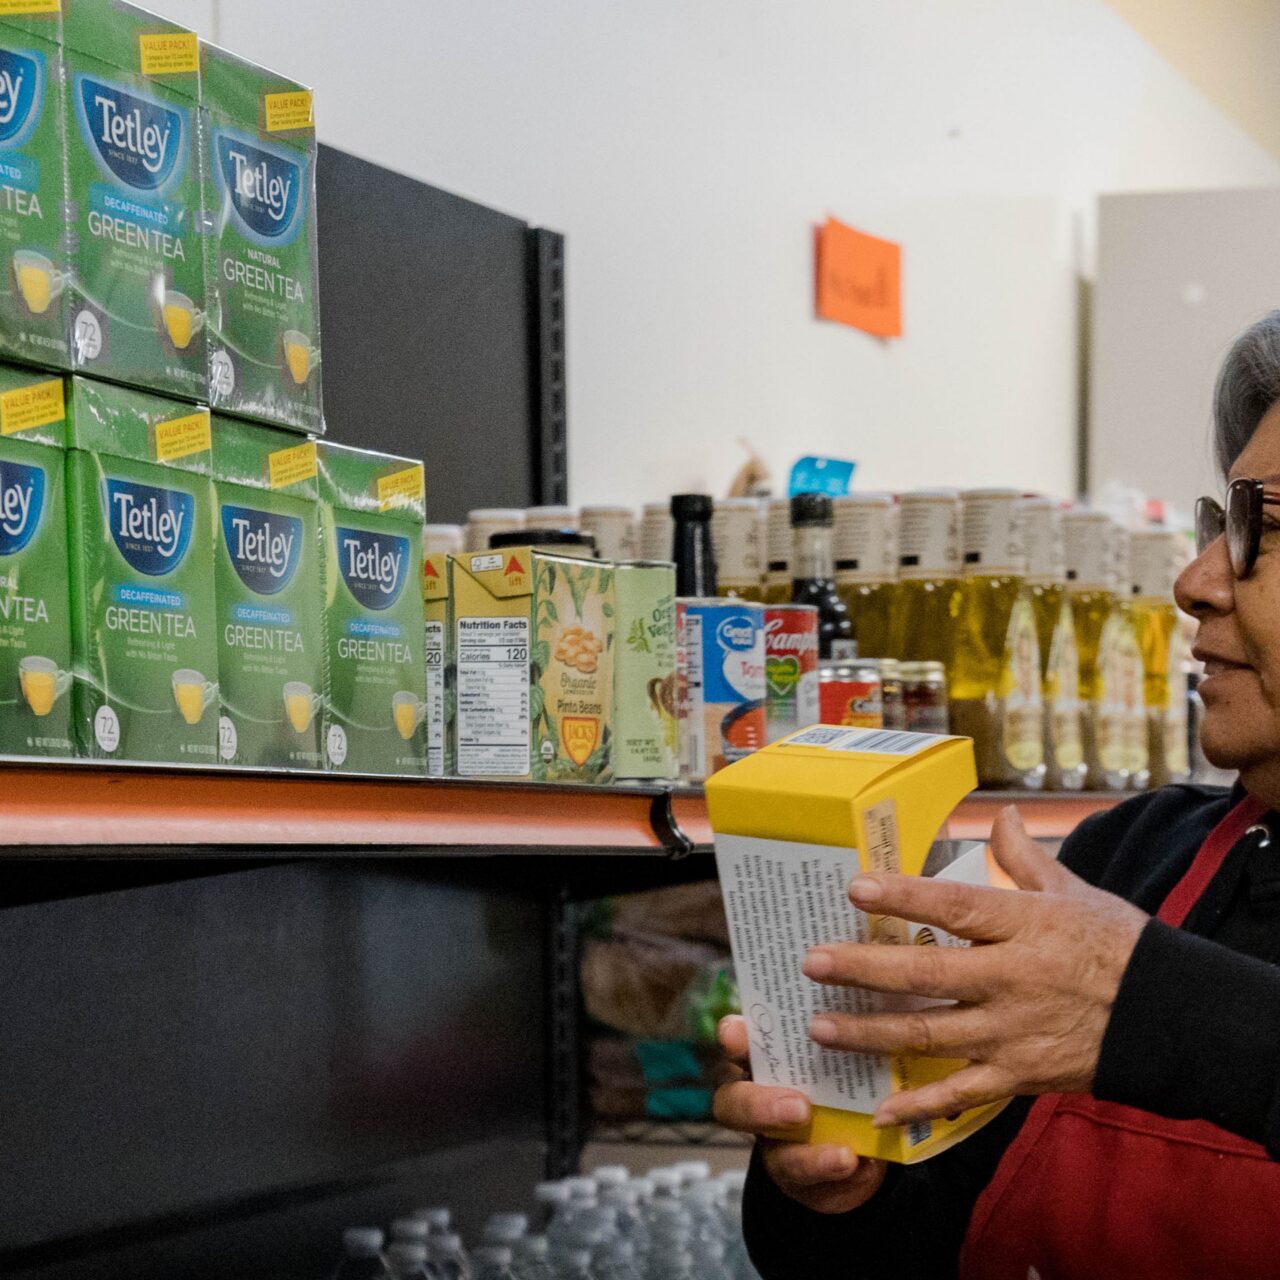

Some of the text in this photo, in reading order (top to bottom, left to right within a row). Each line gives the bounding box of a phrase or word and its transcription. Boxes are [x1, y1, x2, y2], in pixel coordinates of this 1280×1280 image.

[95, 95, 170, 173] Tetley
[229, 151, 291, 220] Tetley
[3, 186, 42, 219] TEA
[104, 195, 168, 225] DECAFFEINATED
[88, 211, 149, 250] GREEN
[151, 229, 186, 262] TEA
[247, 249, 281, 269] NATURAL
[224, 258, 304, 303] GREEN TEA
[81, 321, 96, 342] 72
[159, 425, 182, 439] VALUE
[114, 492, 184, 557] Tetley
[232, 518, 295, 578] Tetley
[344, 539, 402, 594] Tetley
[425, 580, 436, 590] ift
[120, 588, 181, 606] DECAFFEINATED
[13, 597, 49, 623] TEA
[237, 608, 290, 623] DECAFFEINATED
[105, 606, 197, 638] GREEN TEA
[350, 622, 399, 637] DECAFFEINATED
[460, 621, 527, 630] Nutrition Facts
[224, 624, 304, 653] GREEN TEA
[337, 638, 413, 664] GREEN TEA
[426, 652, 441, 664] 20
[460, 648, 527, 660] Calories 120
[557, 700, 602, 714] Pinto Beans
[100, 716, 115, 734] 72
[220, 726, 233, 744] 72
[332, 734, 343, 751] 72
